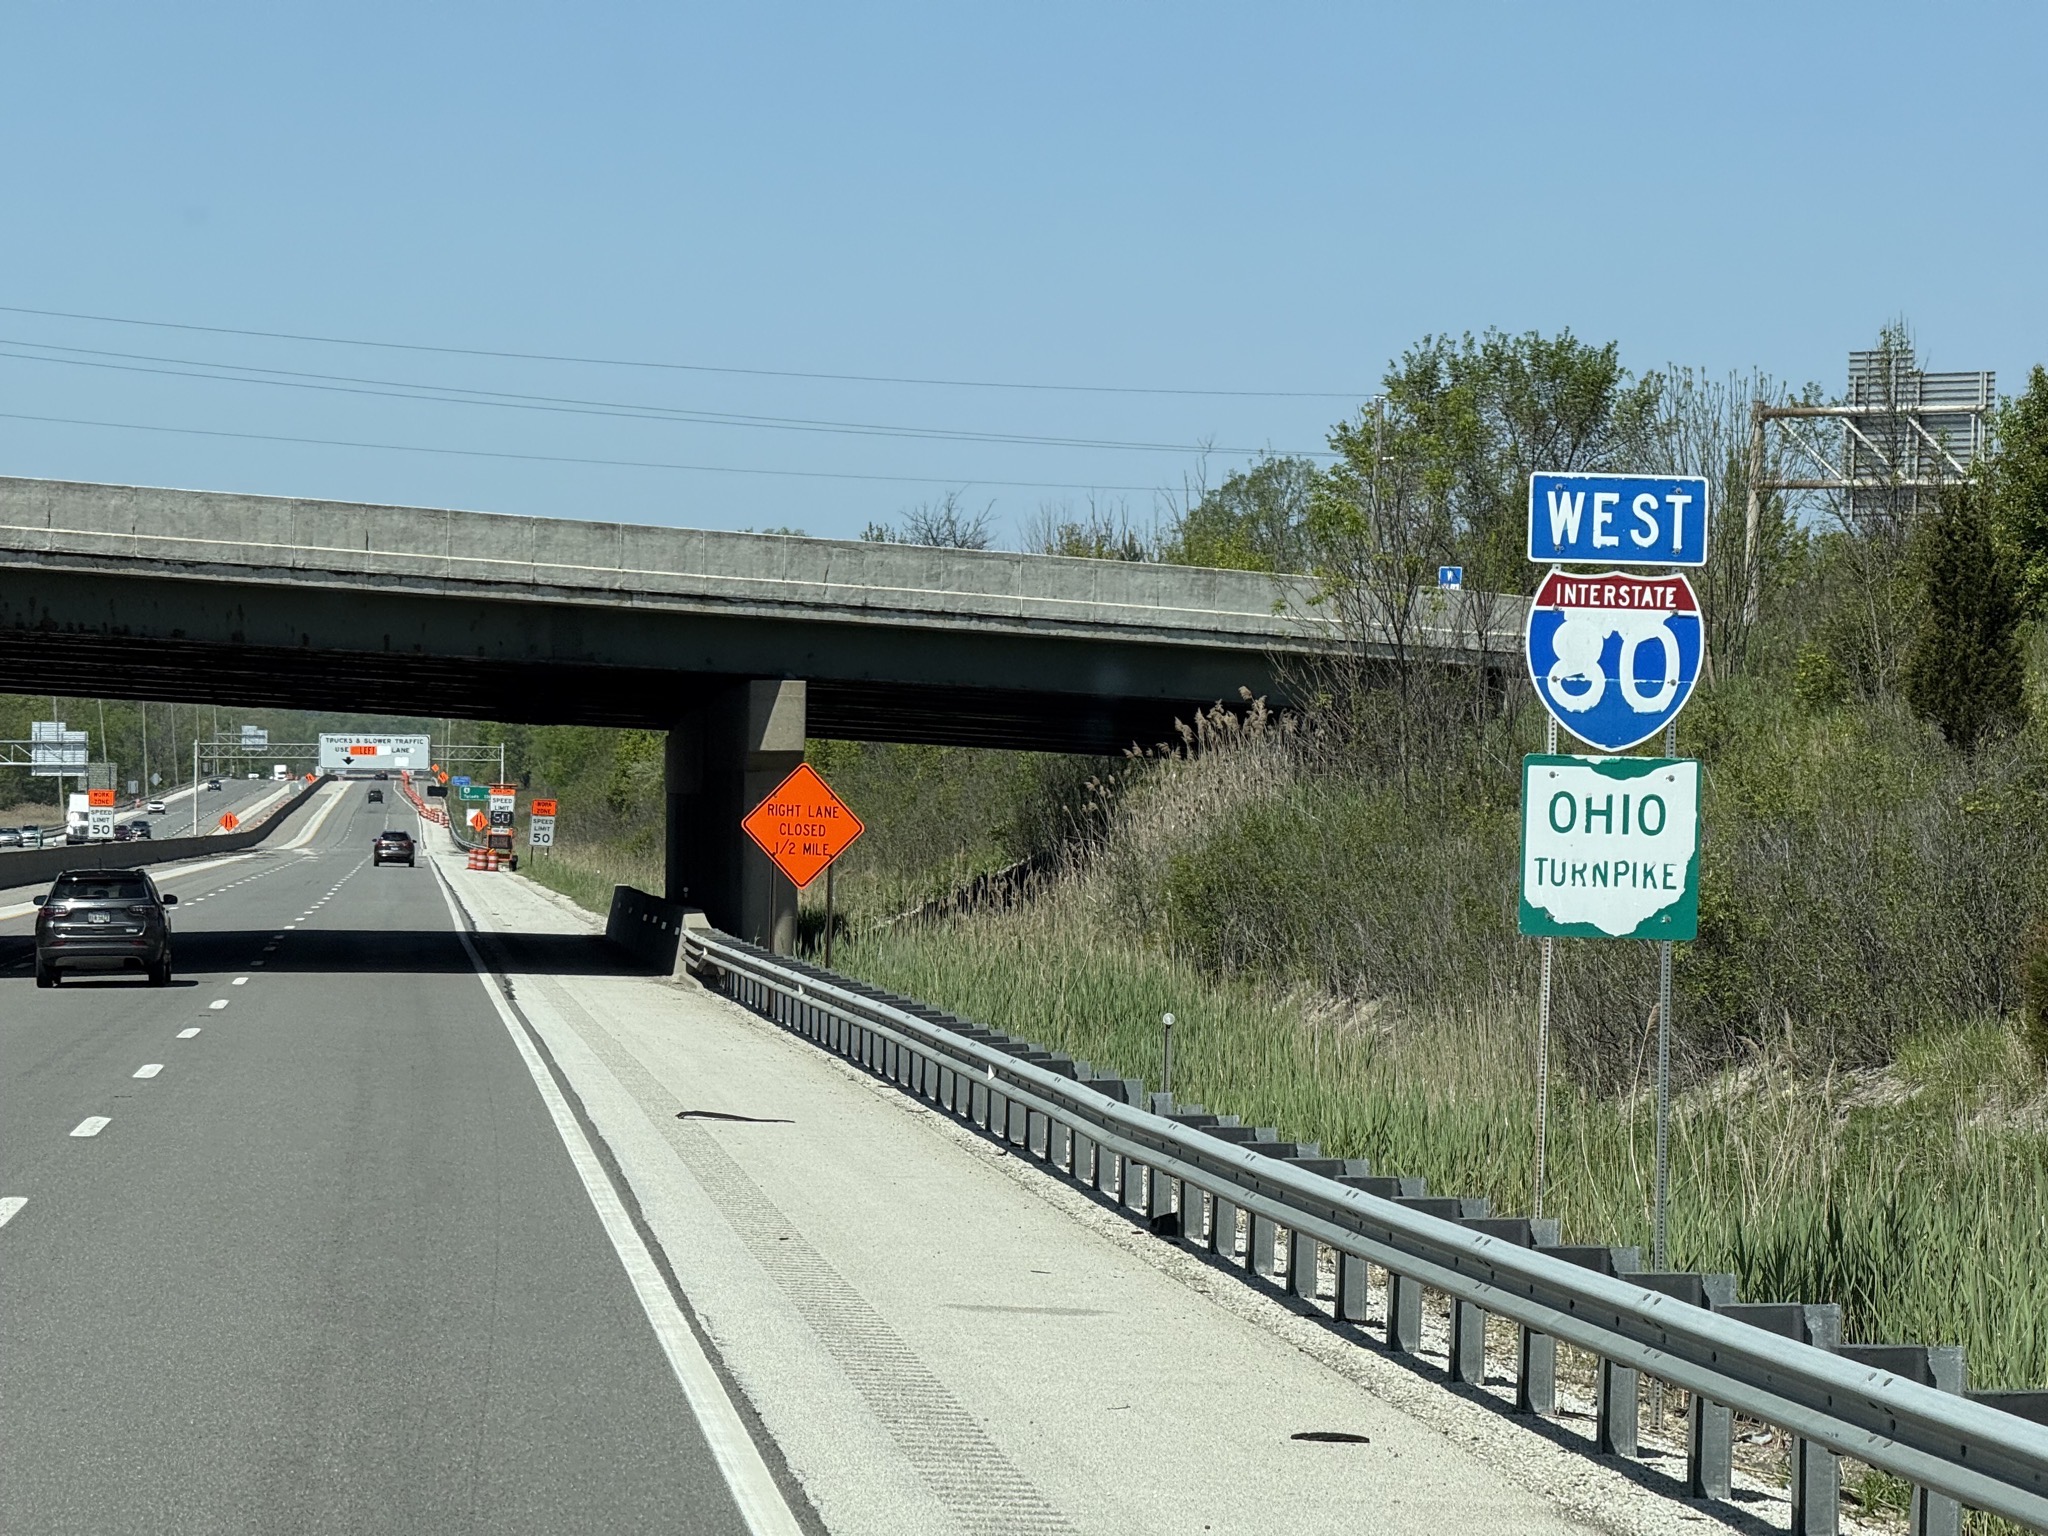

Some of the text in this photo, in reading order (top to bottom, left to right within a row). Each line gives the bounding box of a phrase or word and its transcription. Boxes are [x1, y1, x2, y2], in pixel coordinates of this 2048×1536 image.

[1547, 491, 1692, 550] WEST
[1556, 583, 1677, 608] INTERSTATE
[1547, 617, 1681, 713] 80
[360, 746, 376, 755] LEFT
[492, 812, 510, 824] 50
[767, 803, 840, 819] RIGHT LANE
[1548, 790, 1667, 837] OHIO
[92, 825, 110, 835] 50
[532, 833, 550, 843] 50
[779, 823, 826, 837] CLOSED
[775, 839, 830, 856] 1/2 MILE
[1534, 857, 1677, 890] TURNPIKE
